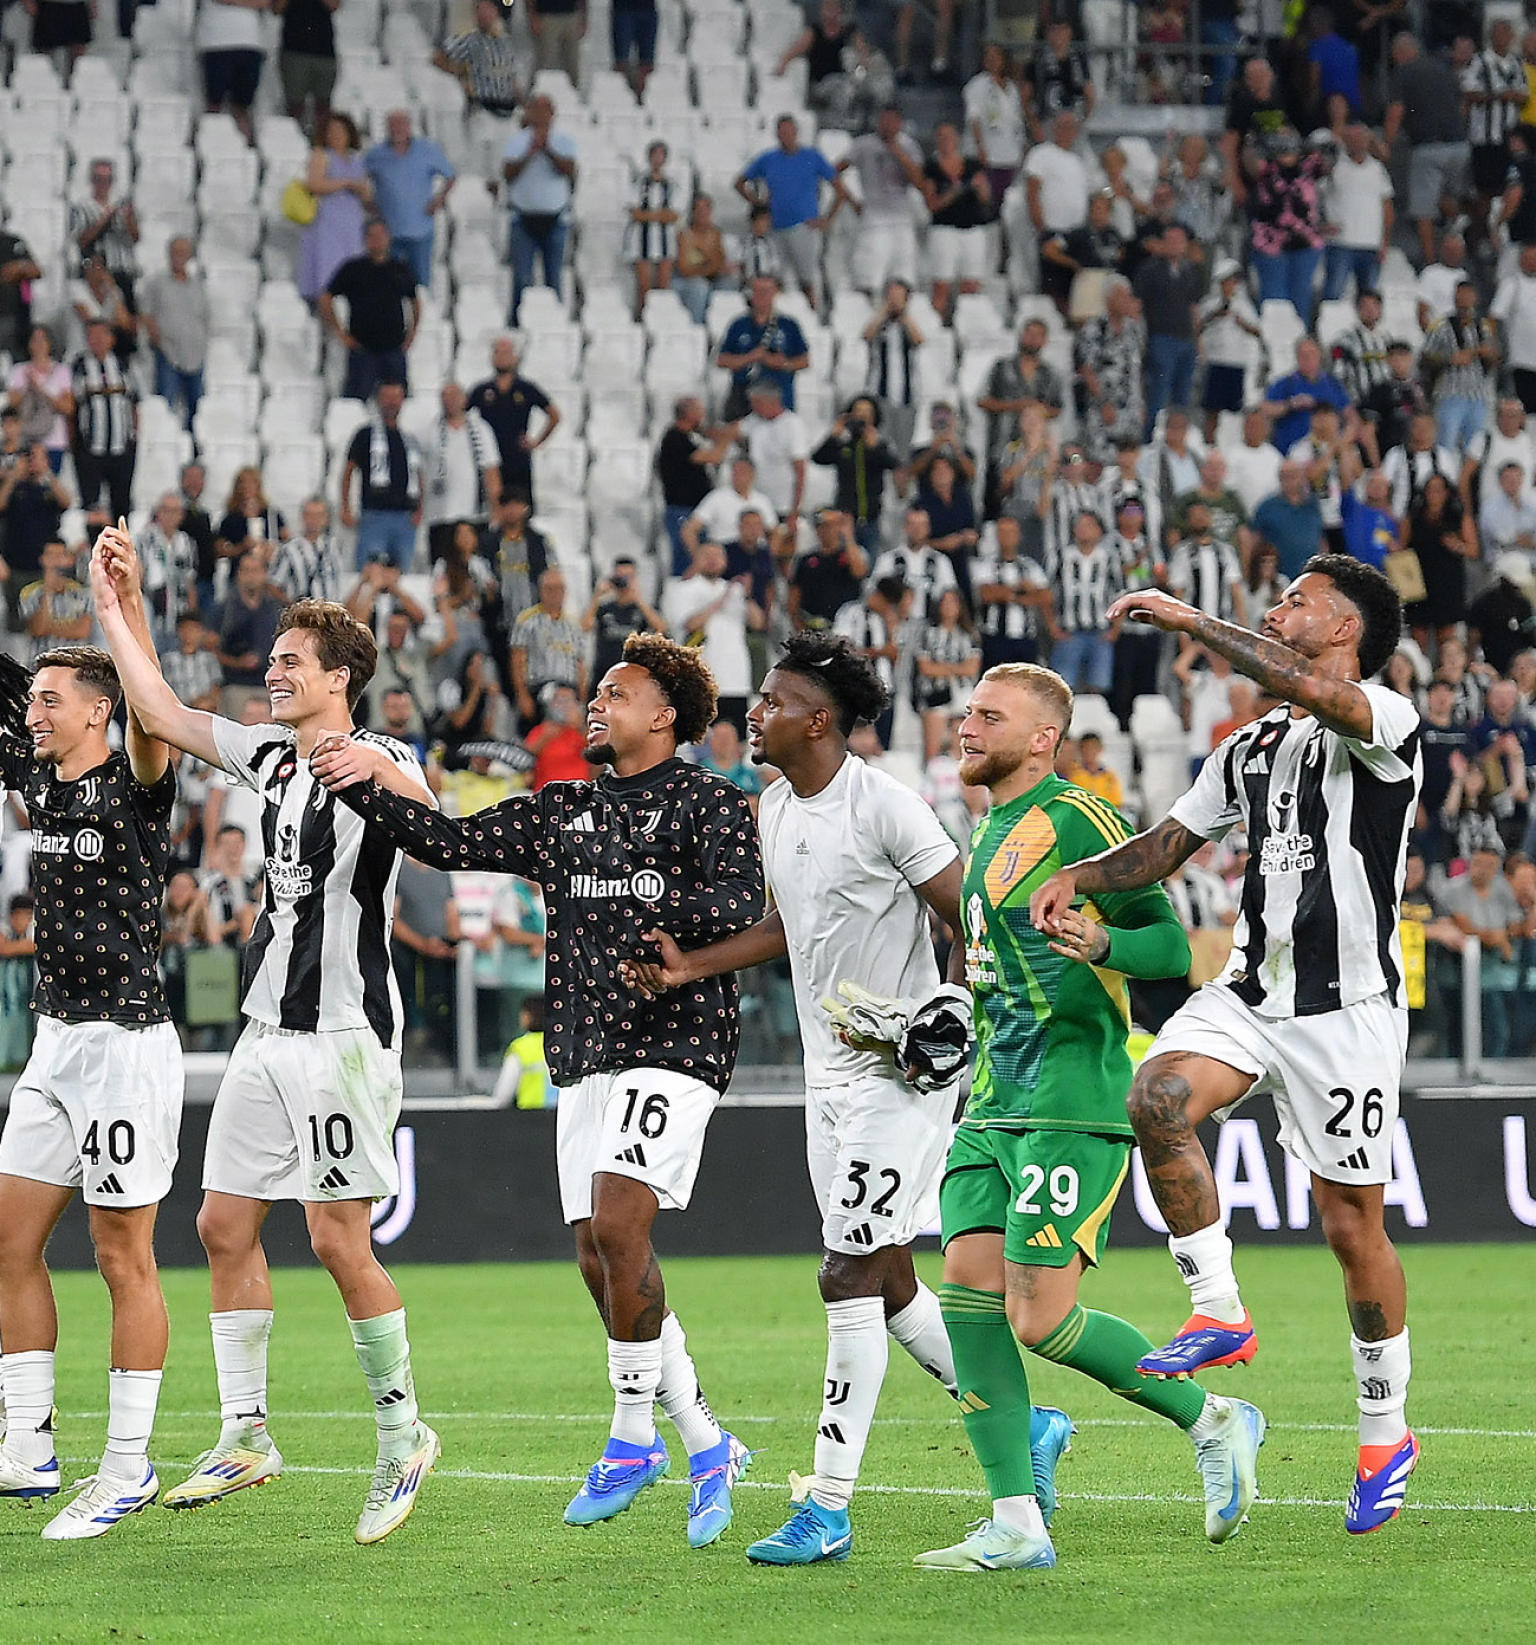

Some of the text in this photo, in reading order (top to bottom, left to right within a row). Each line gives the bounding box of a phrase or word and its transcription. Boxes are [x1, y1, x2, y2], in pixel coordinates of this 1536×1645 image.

[308, 1112, 355, 1162] 10
[620, 1087, 670, 1140] 16
[1324, 1087, 1384, 1139] 26
[81, 1119, 136, 1166] 40
[840, 1159, 902, 1218] 32
[1014, 1163, 1081, 1217] 29
